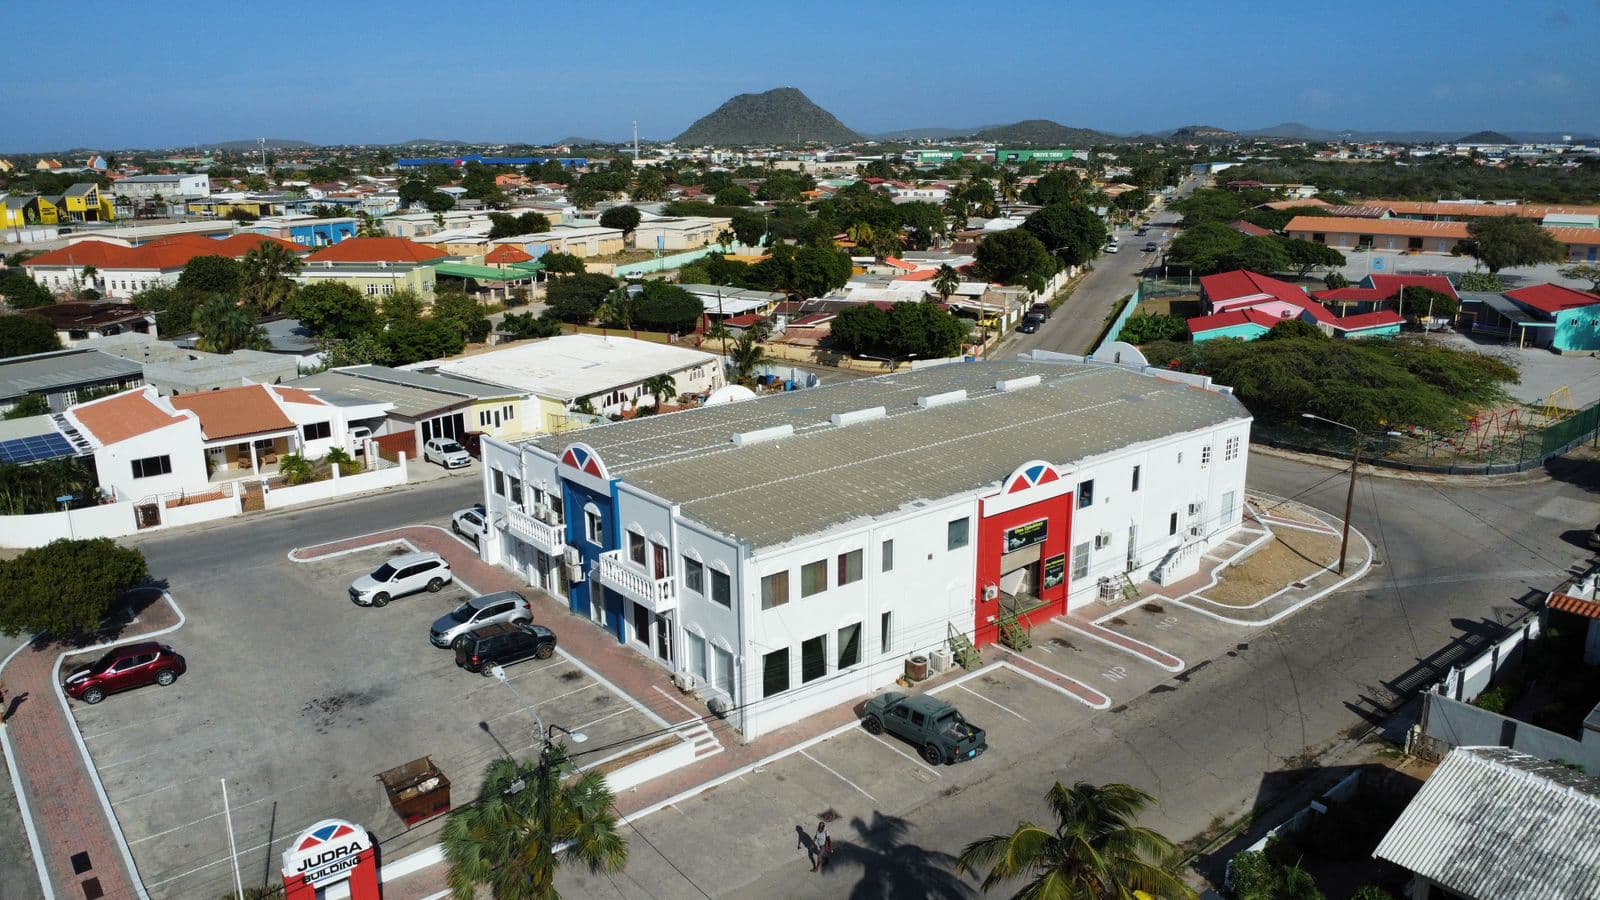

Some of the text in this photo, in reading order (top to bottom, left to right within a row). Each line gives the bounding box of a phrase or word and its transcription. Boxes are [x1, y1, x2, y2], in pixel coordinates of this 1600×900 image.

[1101, 666, 1128, 683] NP
[297, 841, 363, 873] JUDRA
[302, 856, 362, 885] BUILDING
